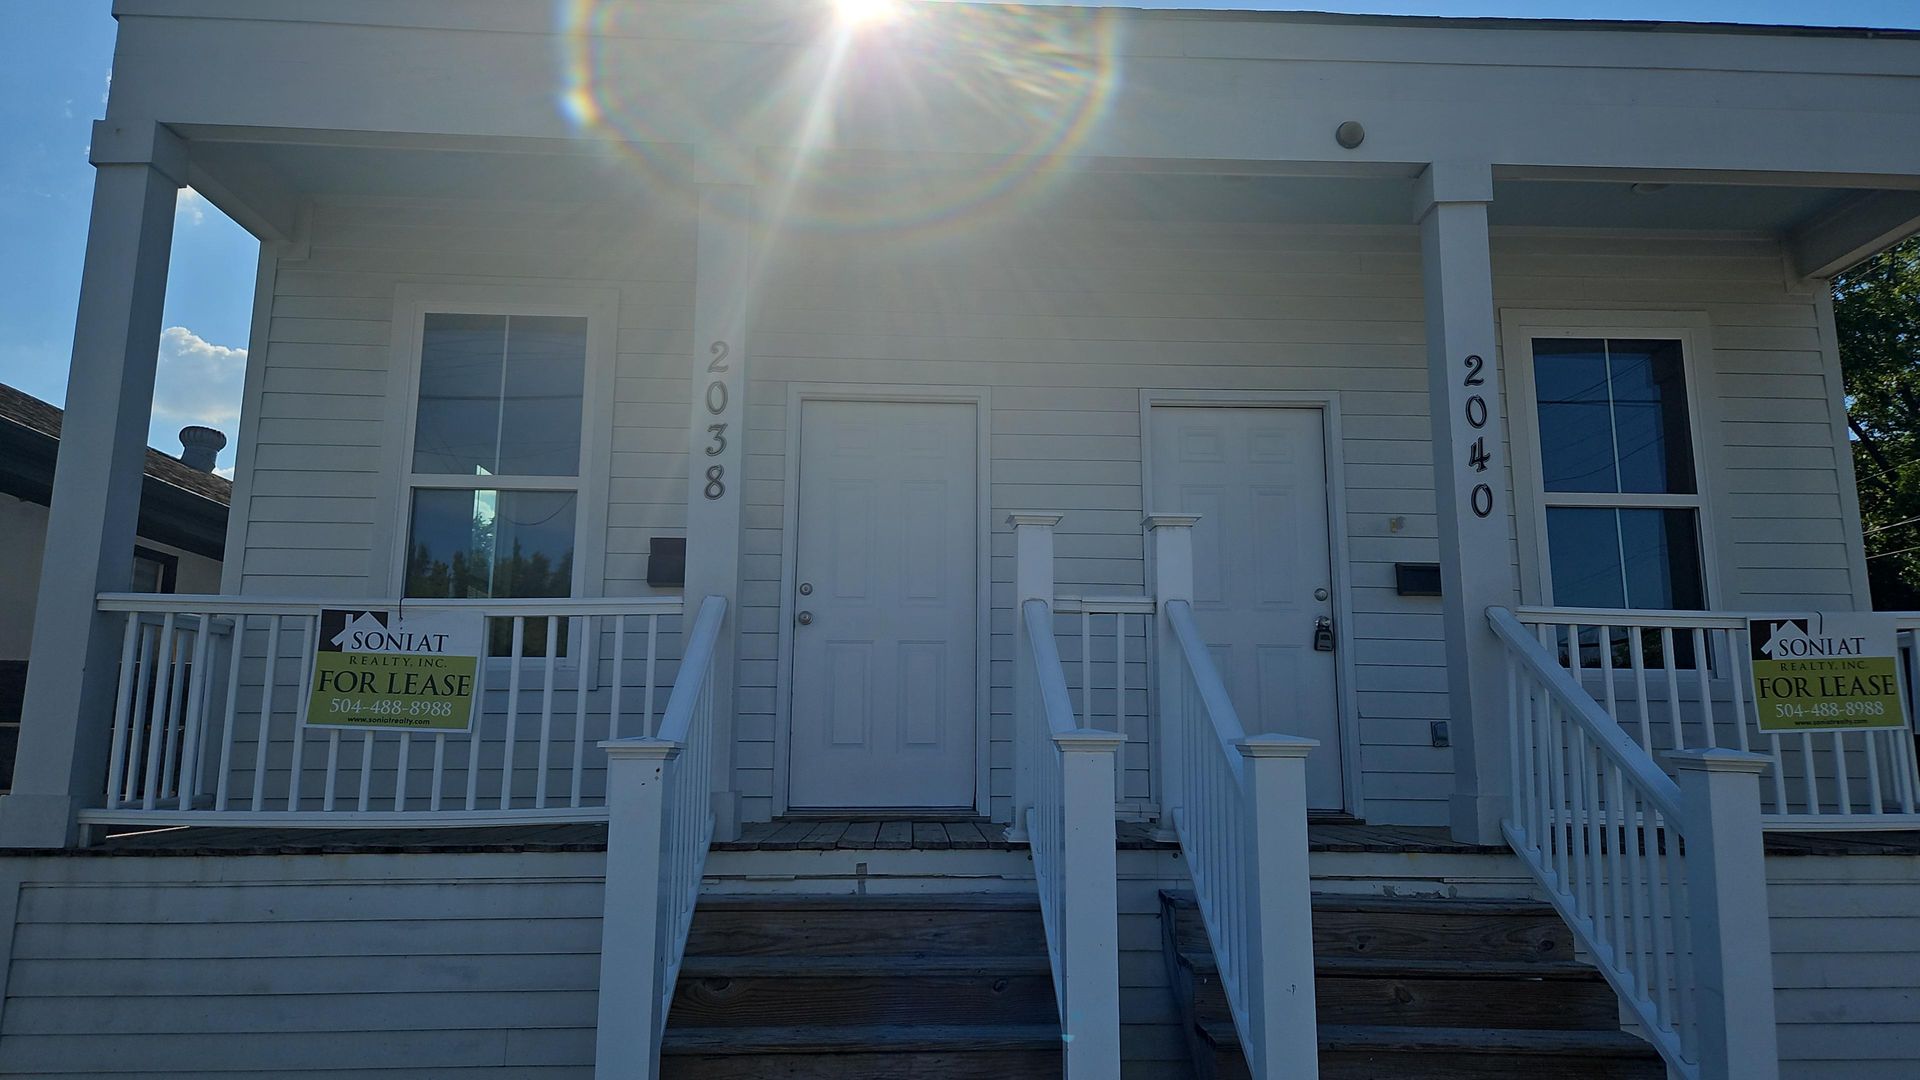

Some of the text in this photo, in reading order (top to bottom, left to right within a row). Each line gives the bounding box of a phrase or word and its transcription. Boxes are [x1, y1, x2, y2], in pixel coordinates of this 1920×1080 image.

[704, 340, 729, 500] 2038
[1464, 354, 1493, 518] 2040
[351, 631, 449, 652] SONIAT
[1779, 637, 1865, 657] SONIAT
[418, 658, 447, 668] INC.
[316, 670, 471, 697] FOR LEASE
[1758, 675, 1896, 699] FOR LEASE
[329, 698, 452, 717] 504-488-8988
[1775, 701, 1885, 718] 504-488-8988
[347, 716, 430, 726] www.soniatrealty.com
